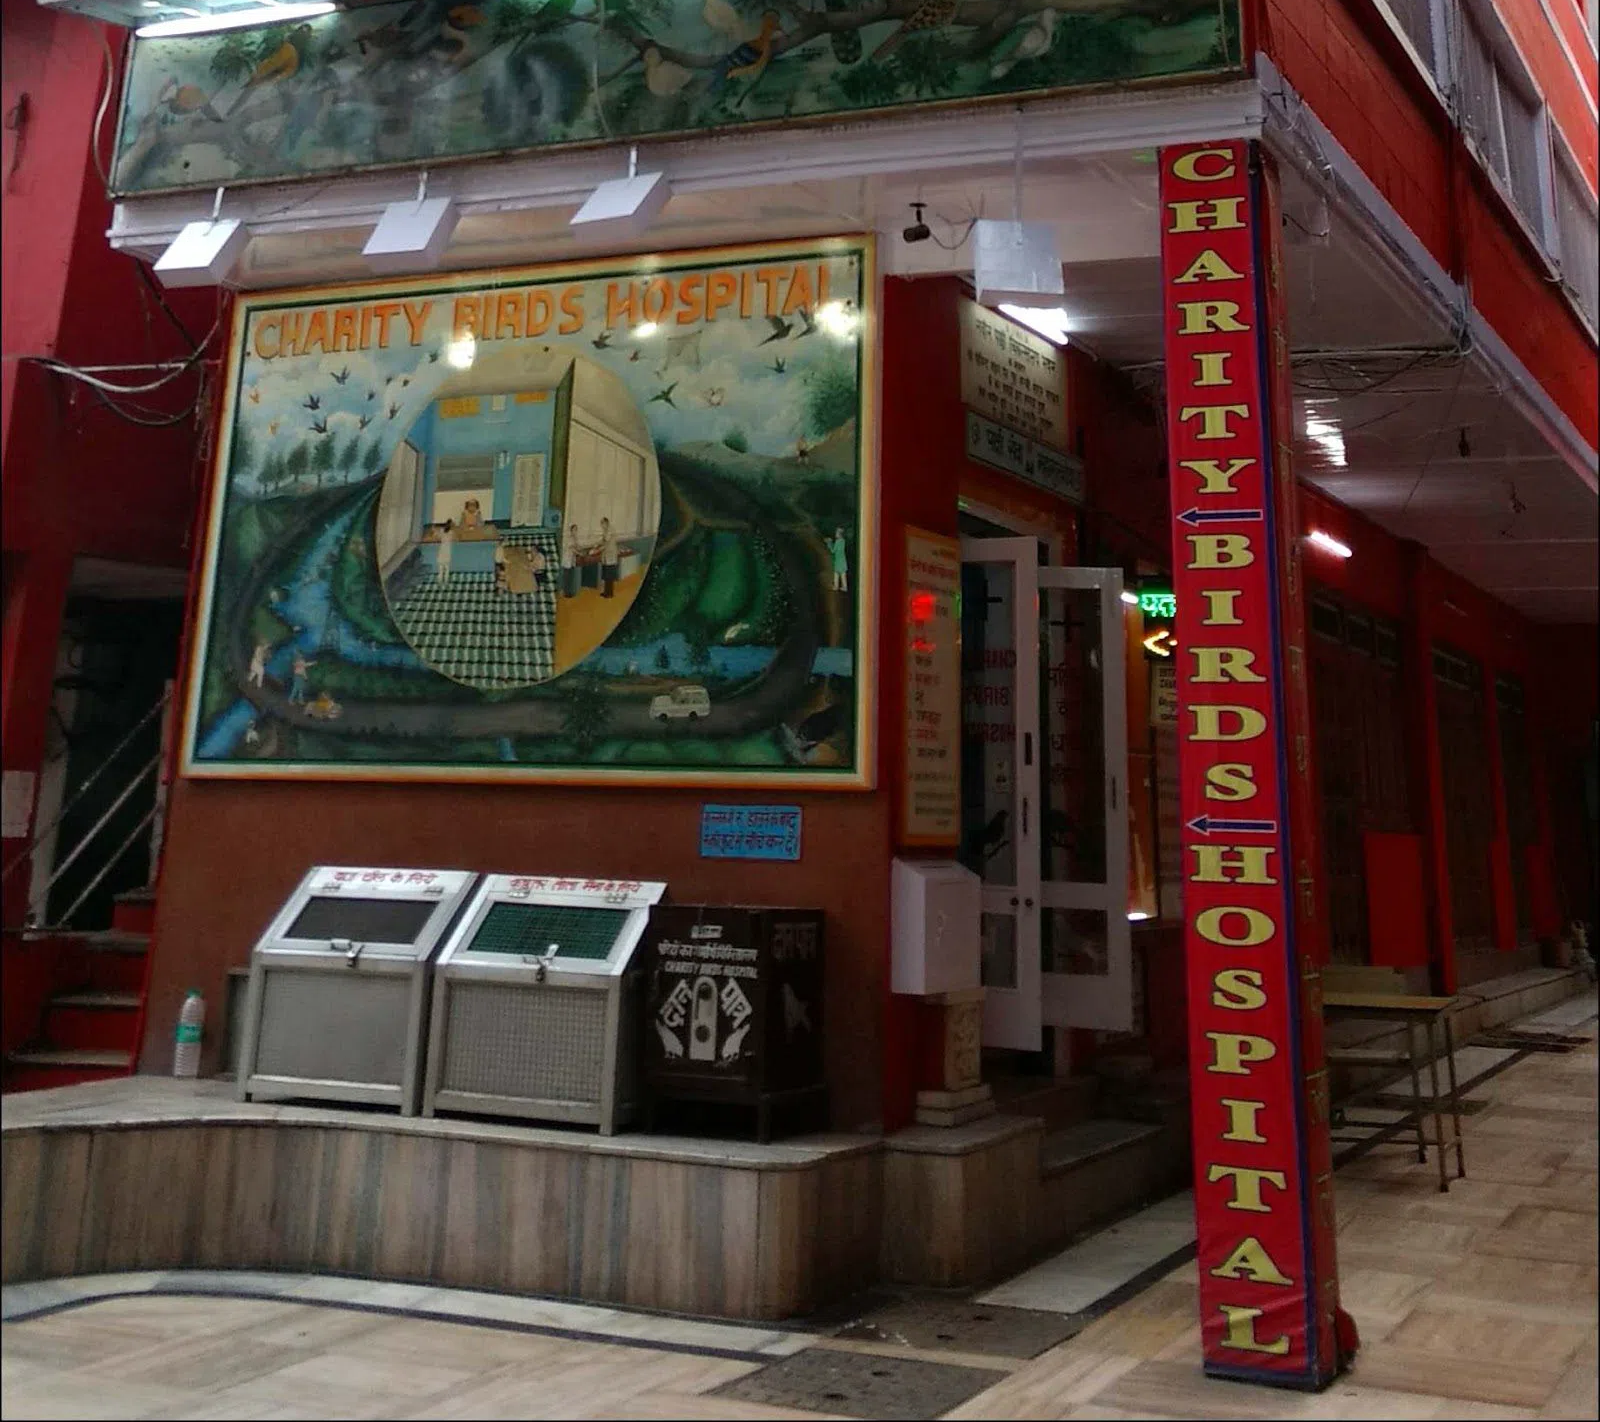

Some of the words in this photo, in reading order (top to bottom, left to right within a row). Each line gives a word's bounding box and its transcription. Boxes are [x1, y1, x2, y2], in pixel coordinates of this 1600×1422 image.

[254, 300, 432, 359] CHARITY
[453, 279, 586, 343] BIRDS
[1167, 148, 1257, 495] CHARITY
[1185, 533, 1268, 803] BIRDS
[1189, 843, 1294, 1356] HOSPITAL
